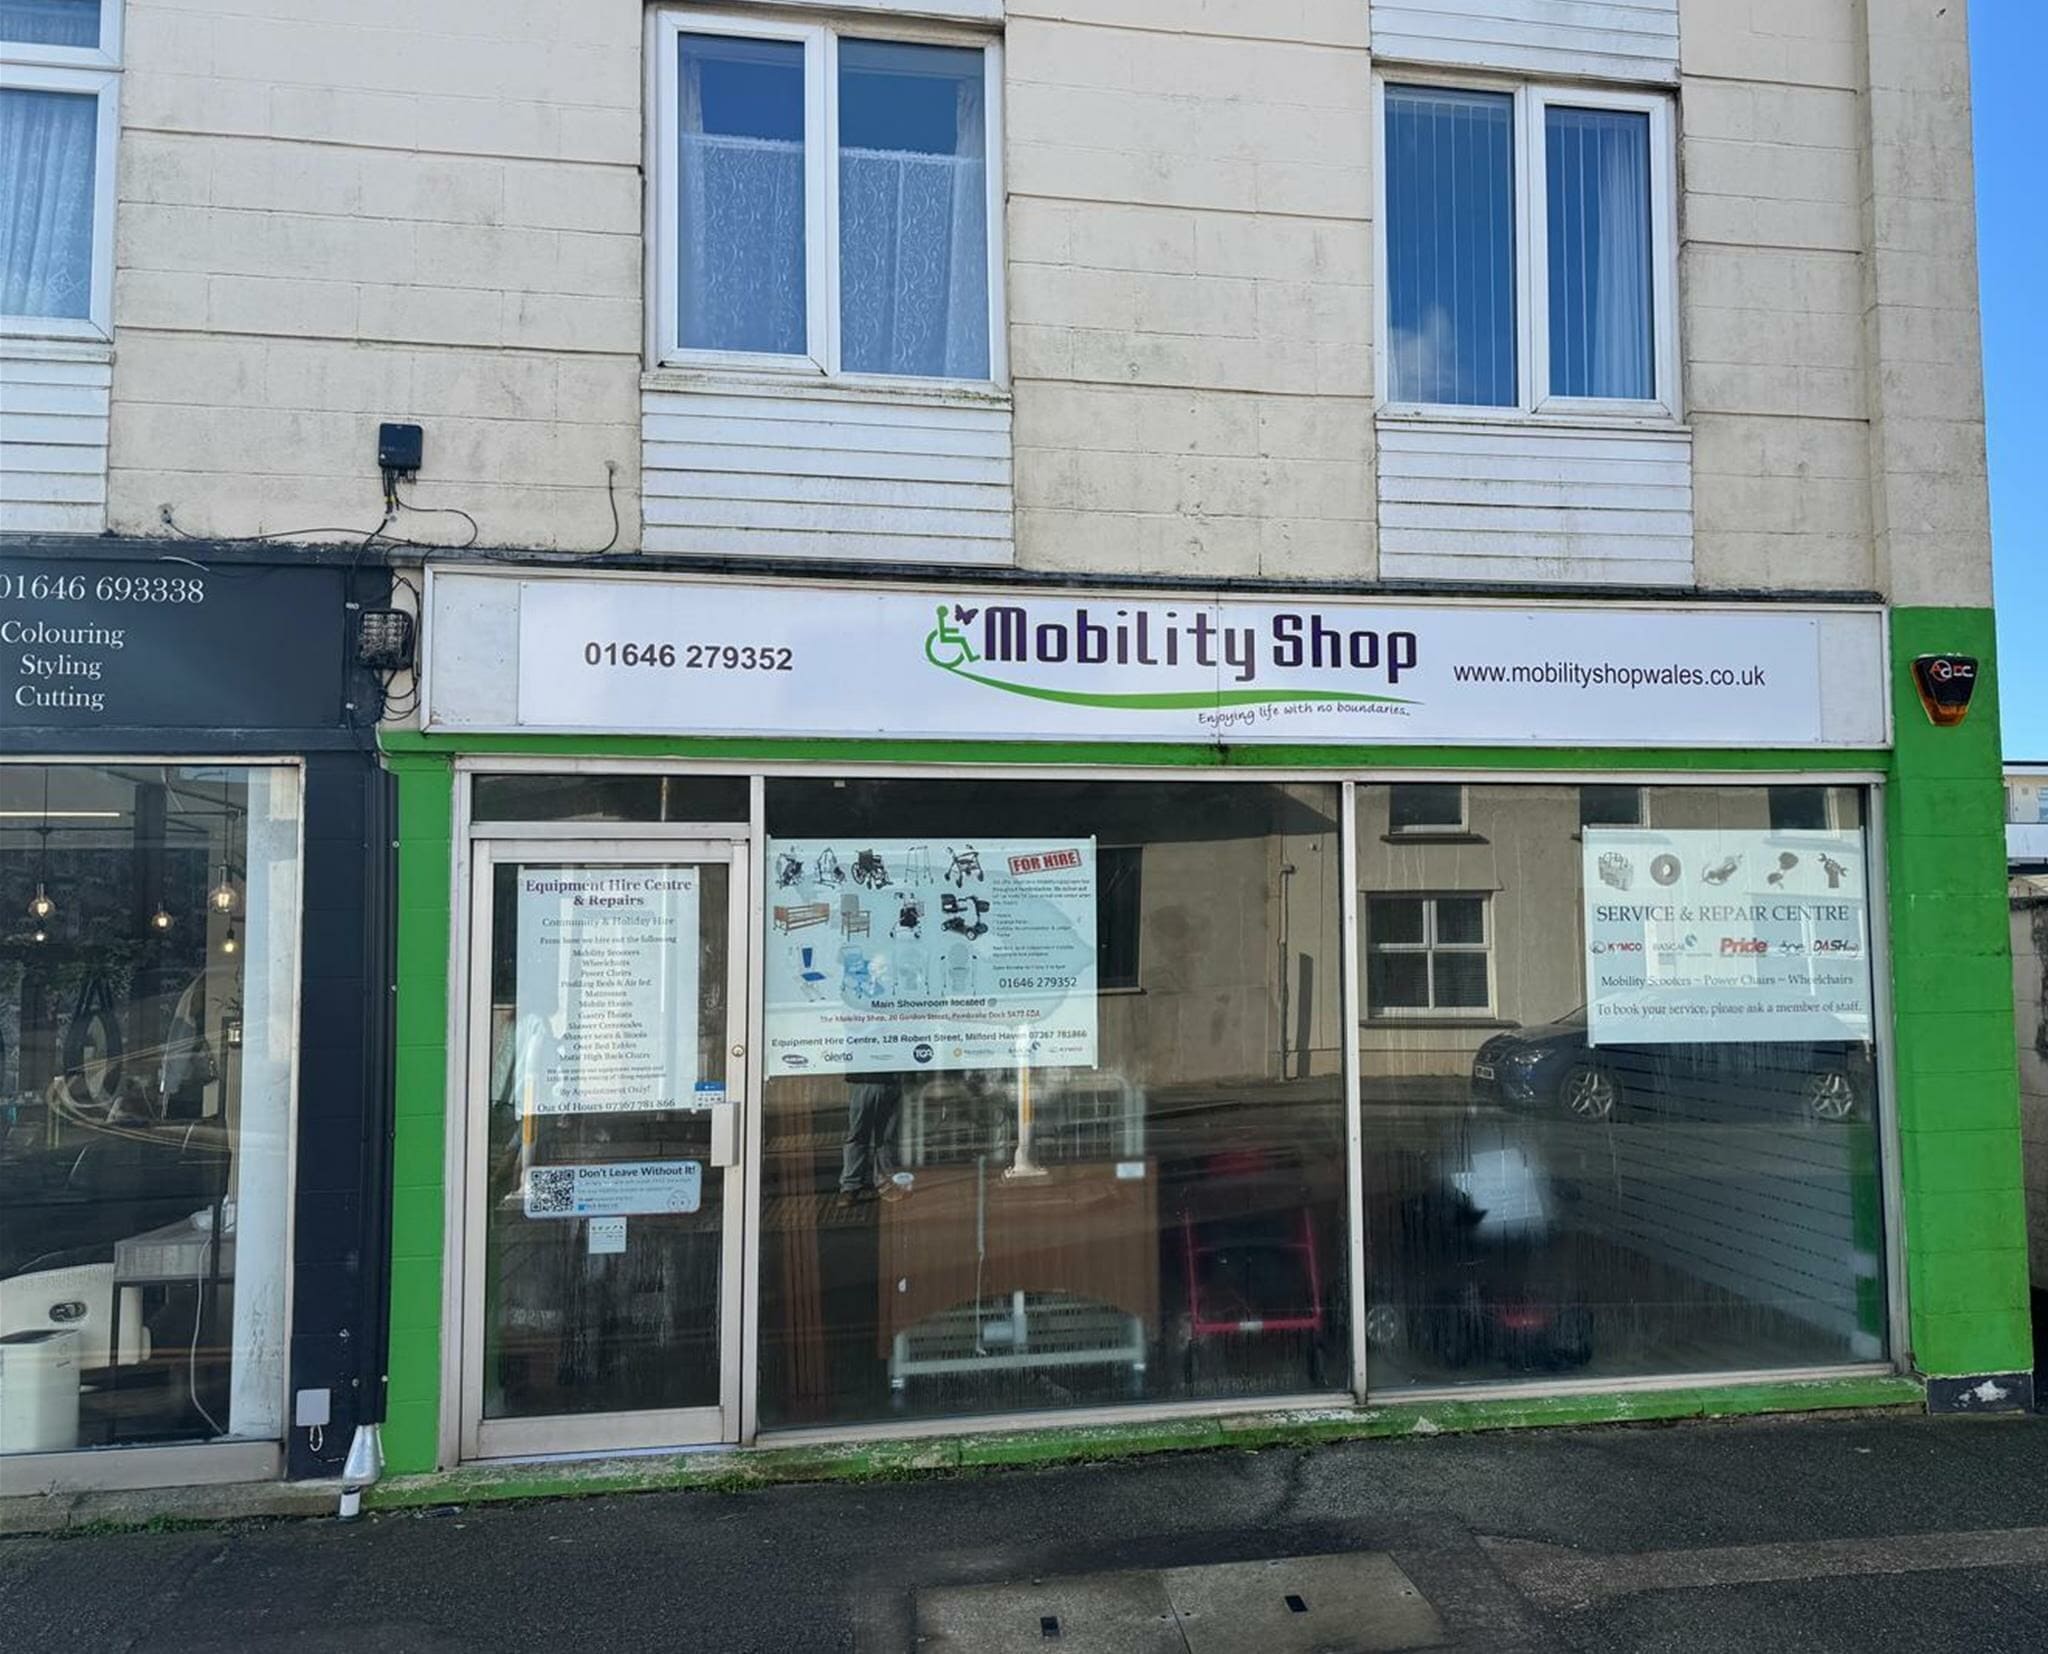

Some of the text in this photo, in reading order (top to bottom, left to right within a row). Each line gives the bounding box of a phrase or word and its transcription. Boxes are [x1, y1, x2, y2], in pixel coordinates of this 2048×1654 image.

[0, 574, 204, 603] 01646 693338
[1, 621, 126, 649] Colouring
[985, 604, 1418, 684] Mobility Shop
[584, 642, 794, 672] 01646 279352
[20, 654, 103, 680] Styling
[1453, 661, 1766, 689] www.mobilityshopwales.co.uk
[15, 685, 105, 712] Cutting
[1198, 709, 1255, 728] Enjoying
[1259, 703, 1279, 721] life
[1283, 702, 1313, 715] with
[1317, 704, 1333, 713] no
[1012, 852, 1077, 872] FOR HIRE
[526, 878, 692, 894] Equipment Hire Centre
[573, 894, 645, 908] & Repairs
[1596, 904, 1849, 921] SERVICE & REPAIR CENTRE
[1720, 937, 1768, 954] Pride
[998, 976, 1077, 989] 01646 279352
[1600, 976, 1646, 989] Mobility
[1704, 975, 1738, 986] Power
[871, 1000, 893, 1008] Main
[897, 999, 947, 1008] Showroom
[950, 998, 985, 1007] located
[1597, 1004, 1612, 1015] To
[1613, 1003, 1640, 1015] book
[1766, 1005, 1773, 1013] a
[1775, 1002, 1821, 1013] member
[1822, 1001, 1834, 1012] of
[772, 1037, 822, 1048] Equipment
[824, 1037, 845, 1046] Hire
[901, 1034, 931, 1044] Robert
[965, 1032, 996, 1042] Milford
[578, 1168, 606, 1179] Don't
[609, 1168, 638, 1177] Leave
[640, 1166, 682, 1177] Without
